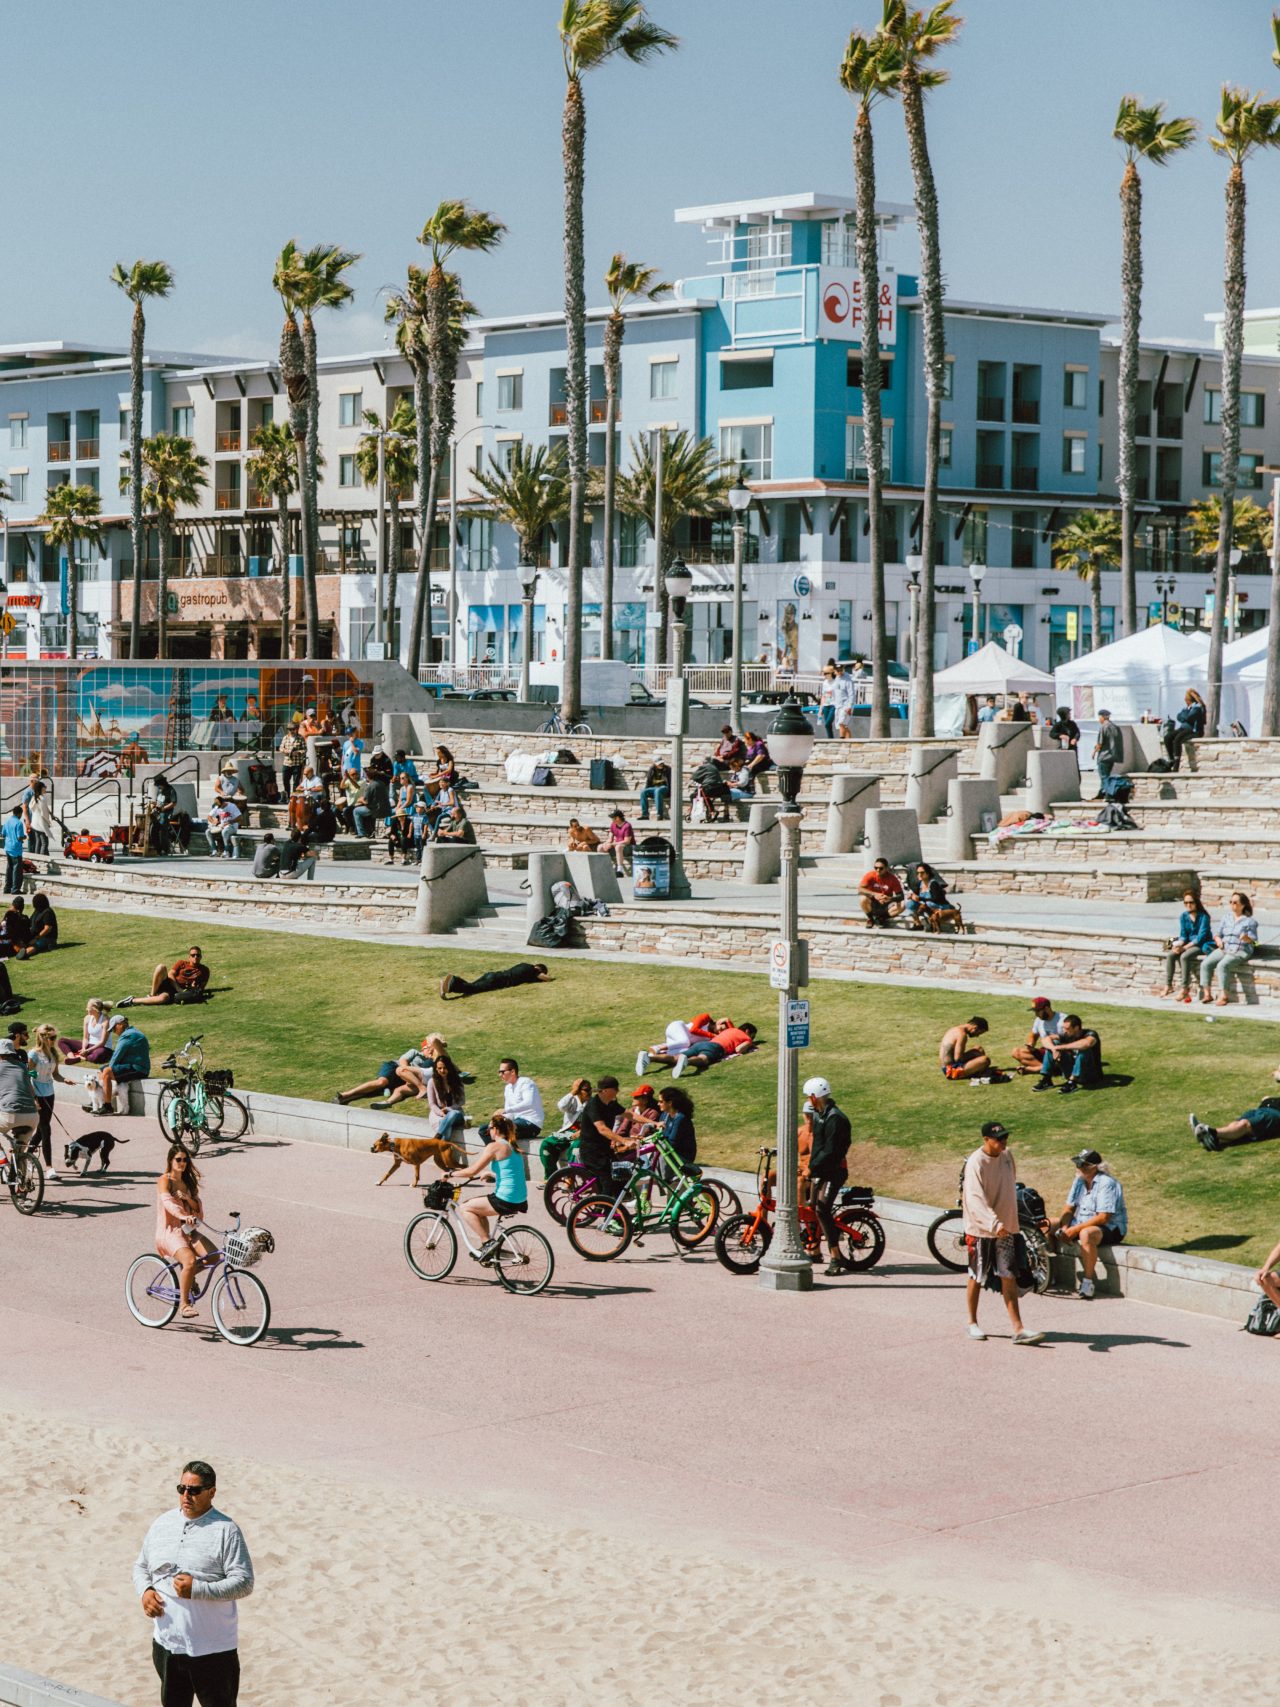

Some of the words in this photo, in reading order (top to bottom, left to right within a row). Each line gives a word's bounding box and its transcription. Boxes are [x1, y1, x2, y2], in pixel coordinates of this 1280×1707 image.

[879, 284, 892, 306] &
[852, 306, 893, 332] PH
[180, 591, 228, 608] gastropub
[790, 1003, 806, 1011] NOTICE
